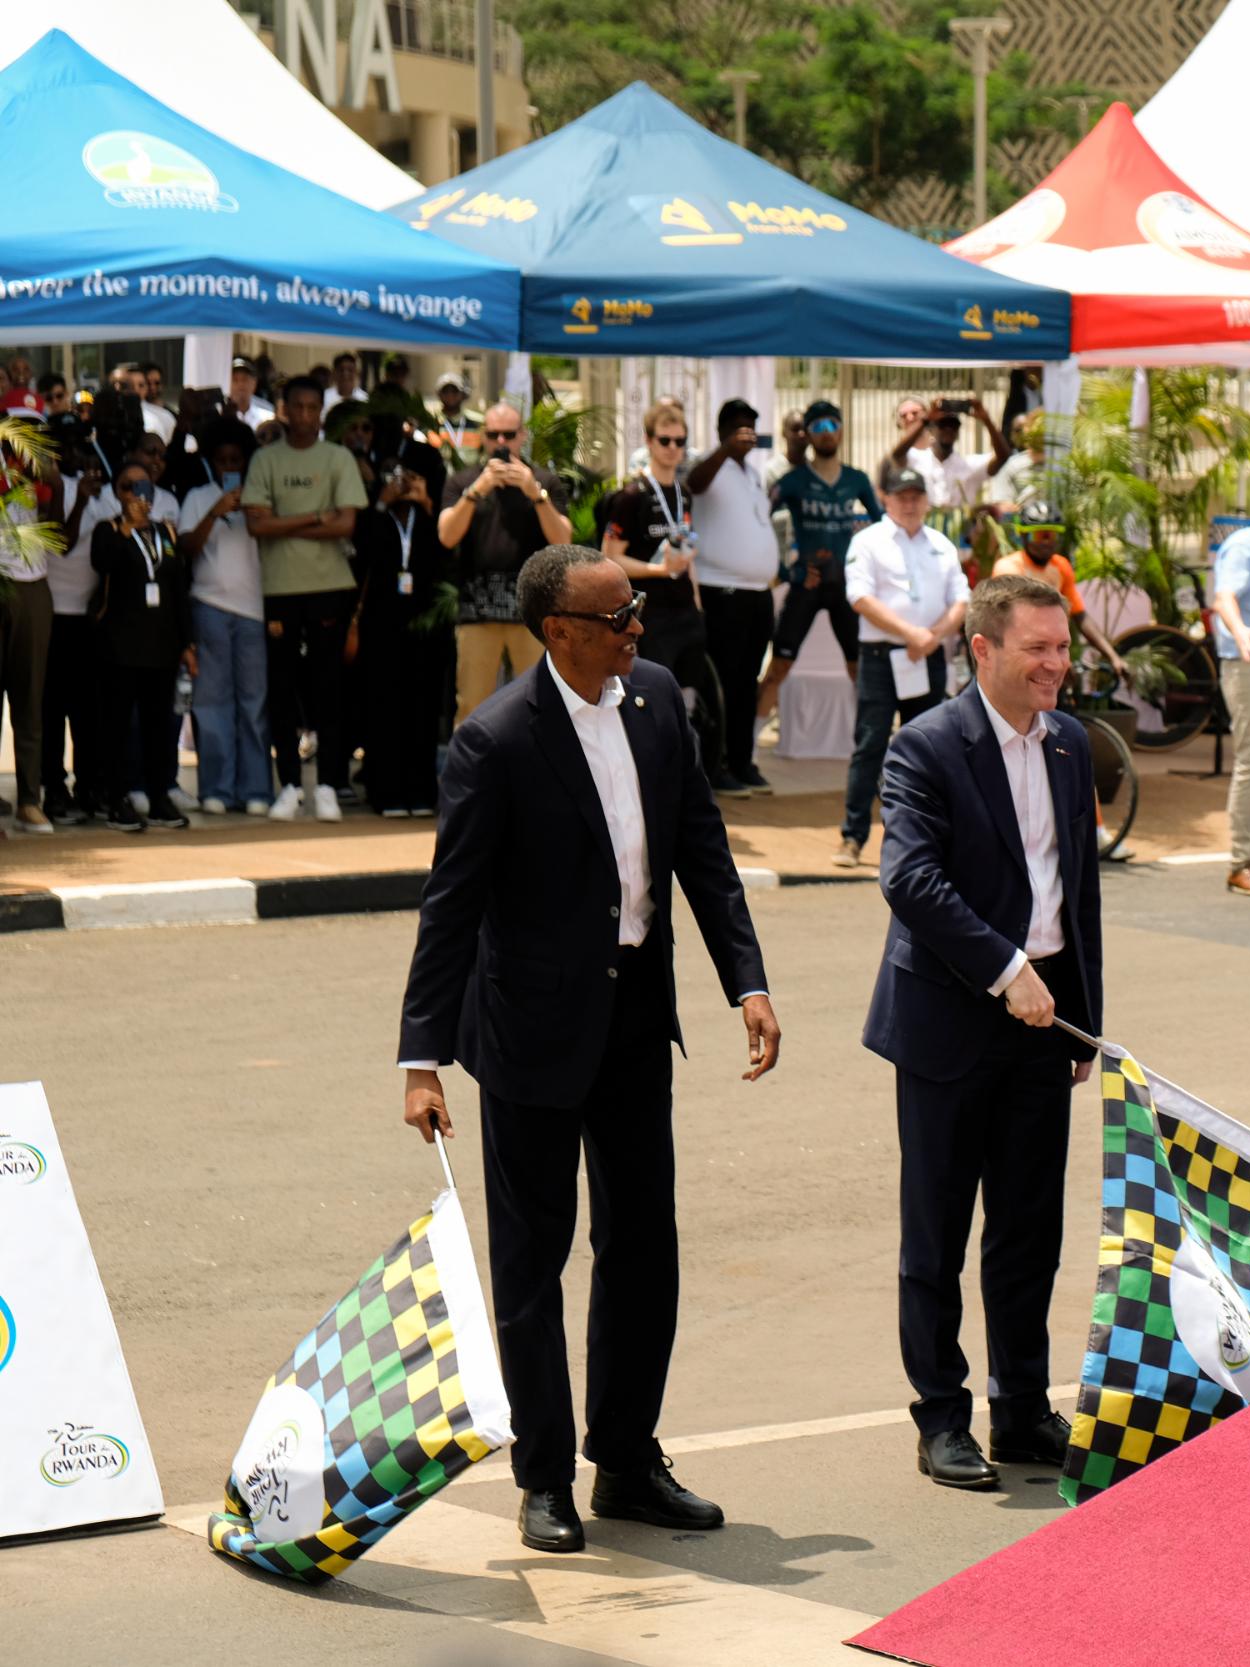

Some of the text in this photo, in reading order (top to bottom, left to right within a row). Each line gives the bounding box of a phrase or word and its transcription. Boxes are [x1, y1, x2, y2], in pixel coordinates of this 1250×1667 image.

[728, 200, 847, 231] MoMo
[83, 269, 129, 296] the
[140, 274, 268, 303] moment,
[276, 276, 370, 315] always
[378, 284, 482, 327] inyange
[602, 299, 654, 318] MoMo
[993, 309, 1040, 328] MoMo
[52, 1454, 119, 1475] RWANDA
